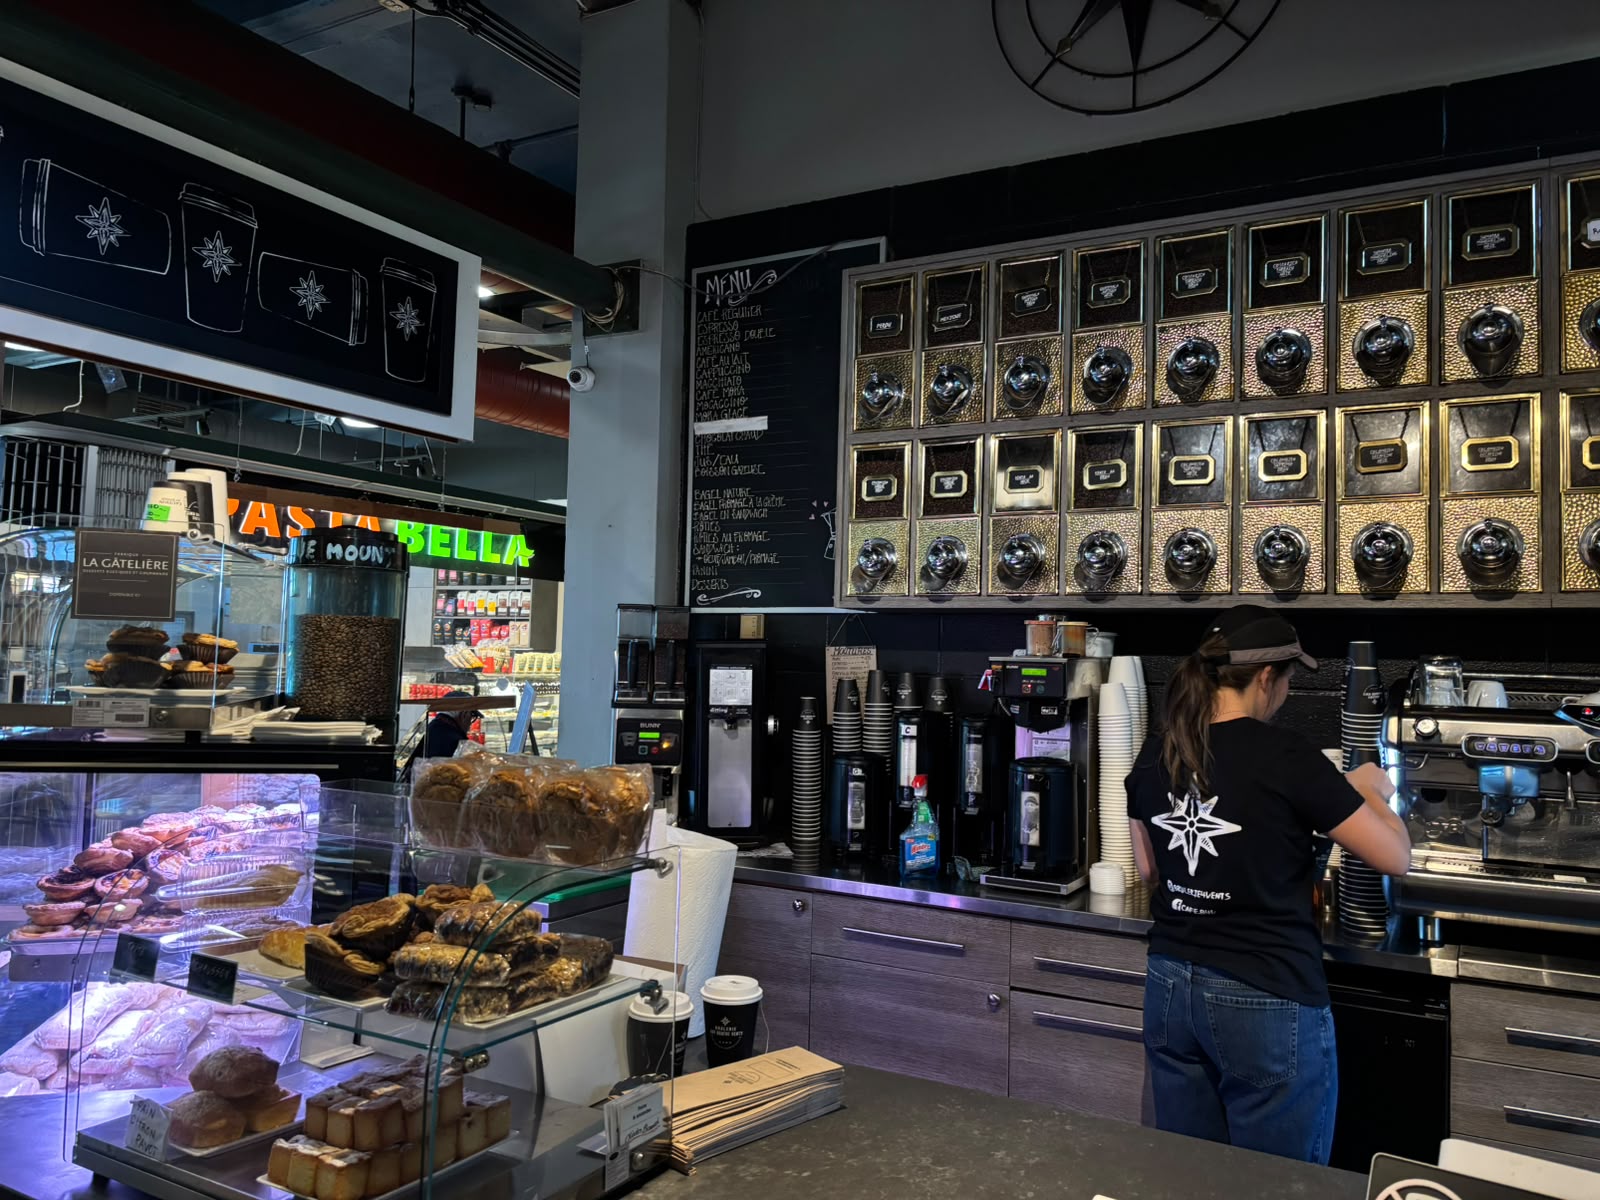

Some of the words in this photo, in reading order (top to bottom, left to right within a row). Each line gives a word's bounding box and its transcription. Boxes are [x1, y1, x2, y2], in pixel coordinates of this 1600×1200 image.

[704, 268, 752, 306] MENU
[394, 519, 535, 567] BELLA
[83, 558, 98, 567] LA
[101, 557, 169, 570] GÂTELIÈRE
[136, 1101, 156, 1119] PAIN
